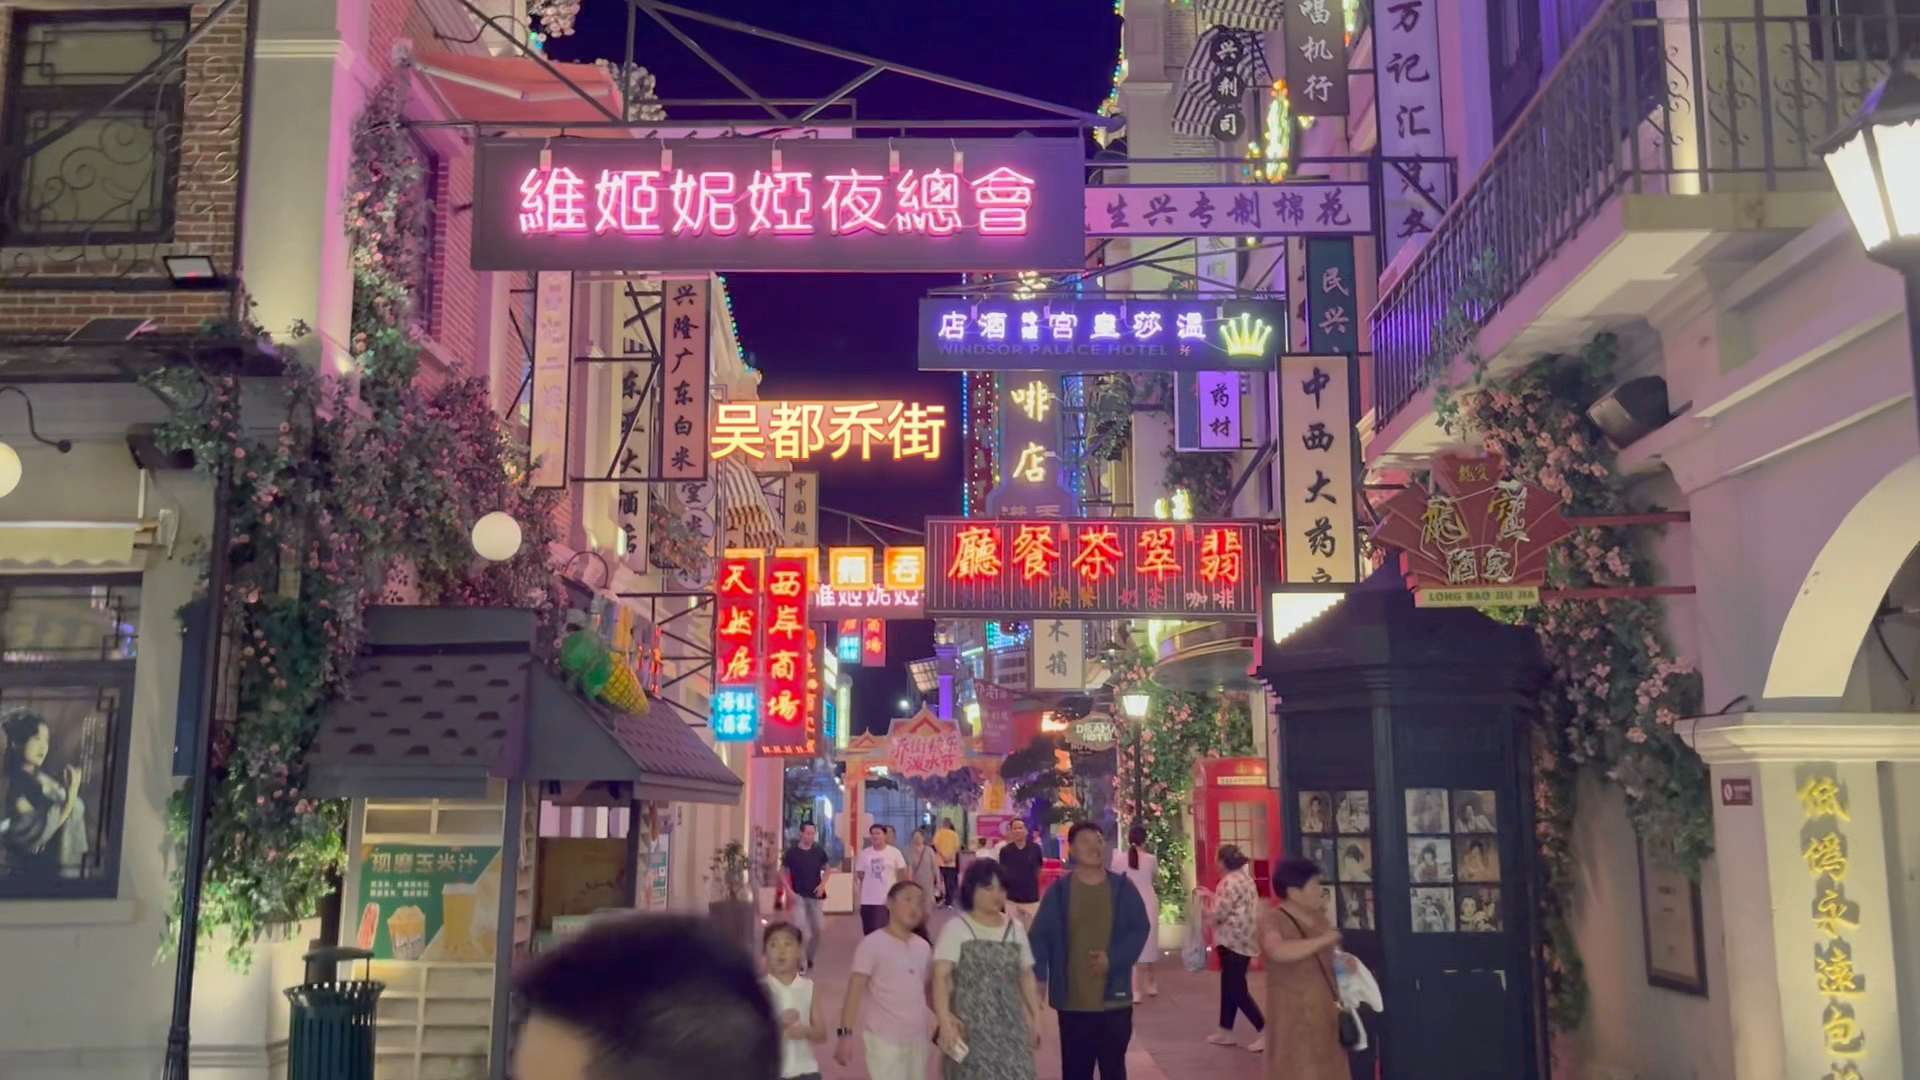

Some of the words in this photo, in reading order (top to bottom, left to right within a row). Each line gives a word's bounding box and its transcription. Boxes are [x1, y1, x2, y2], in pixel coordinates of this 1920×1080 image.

[1085, 188, 1352, 230] 生兴专制棉花
[1318, 266, 1350, 353] 民兴
[938, 343, 1023, 357] WINDSOR
[1030, 343, 1101, 357] PALACE
[1108, 343, 1169, 357] HOTEL
[671, 283, 699, 472] 兴隆广东白米
[1428, 592, 1462, 602] LONG
